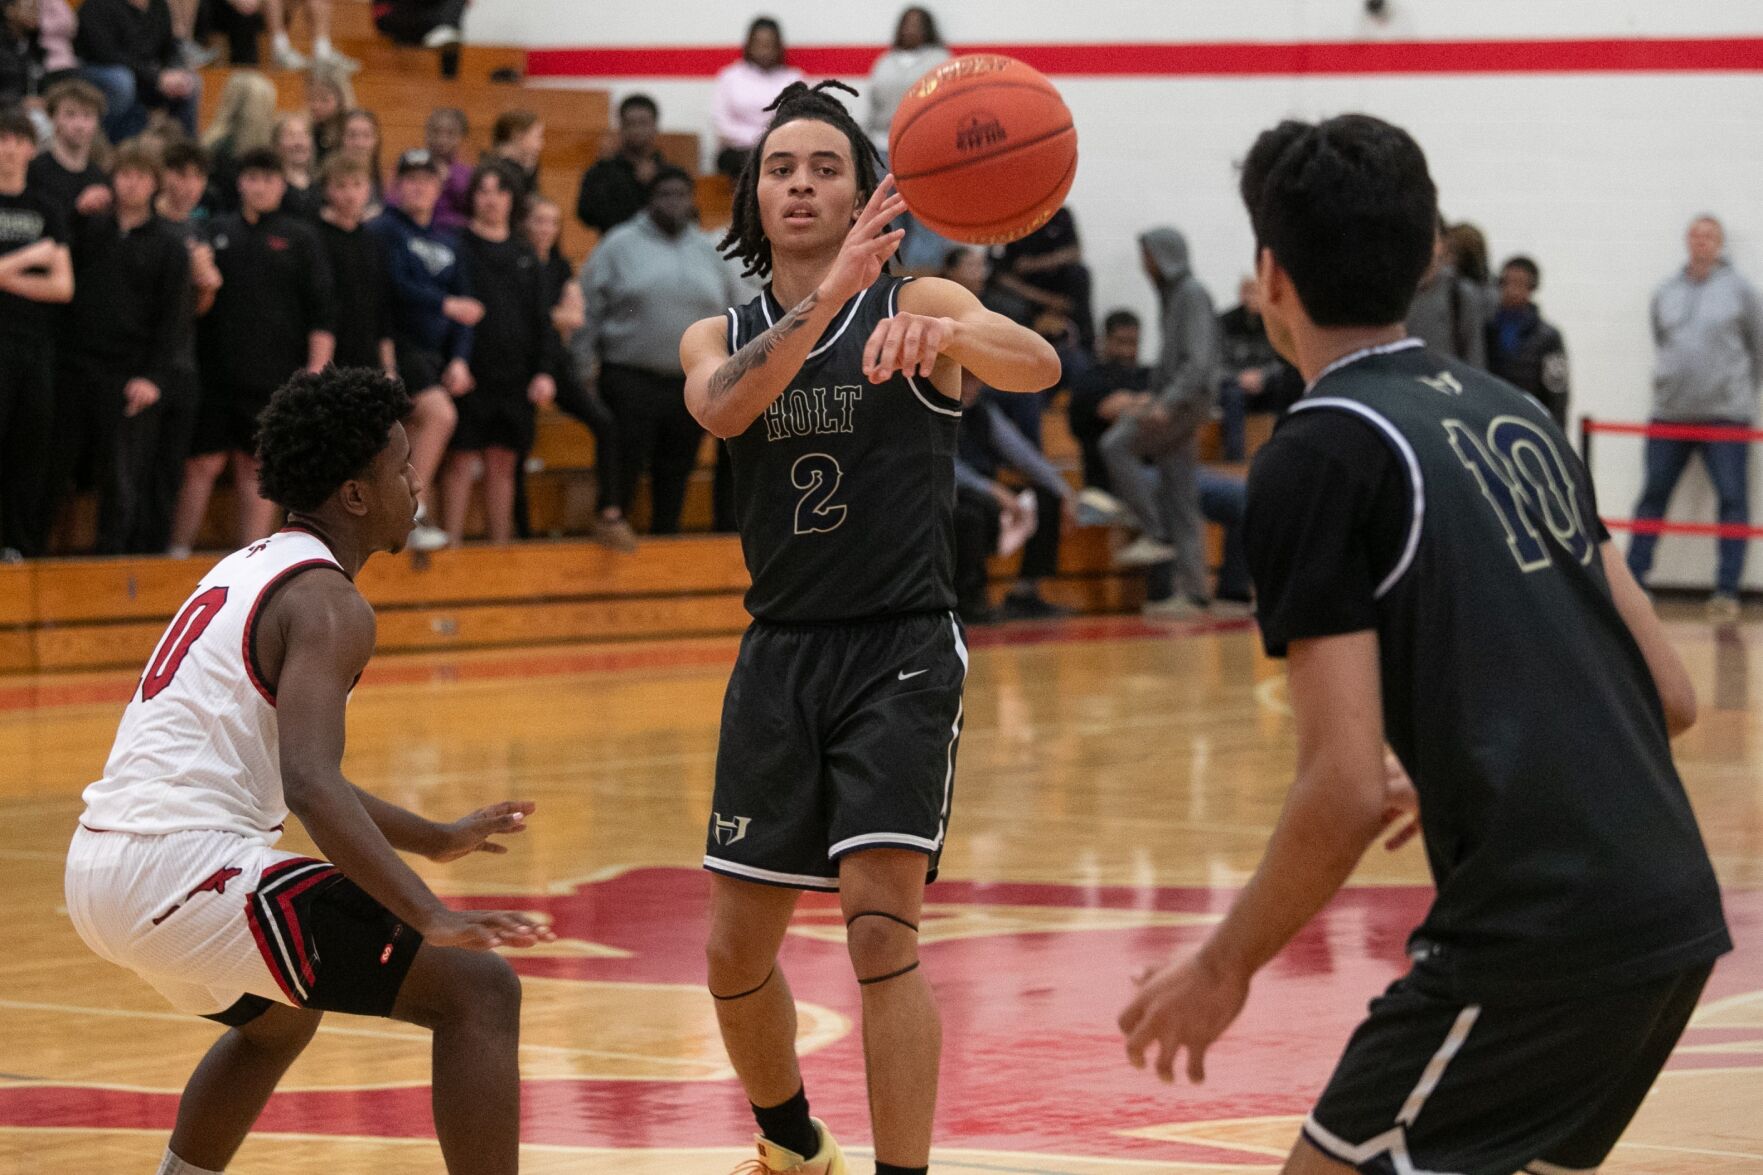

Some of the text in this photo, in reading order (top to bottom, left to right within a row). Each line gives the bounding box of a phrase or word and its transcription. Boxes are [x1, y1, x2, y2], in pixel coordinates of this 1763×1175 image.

[764, 385, 862, 441] HOLT
[791, 453, 848, 534] 2
[1441, 415, 1594, 573] 10
[129, 584, 230, 703] 0
